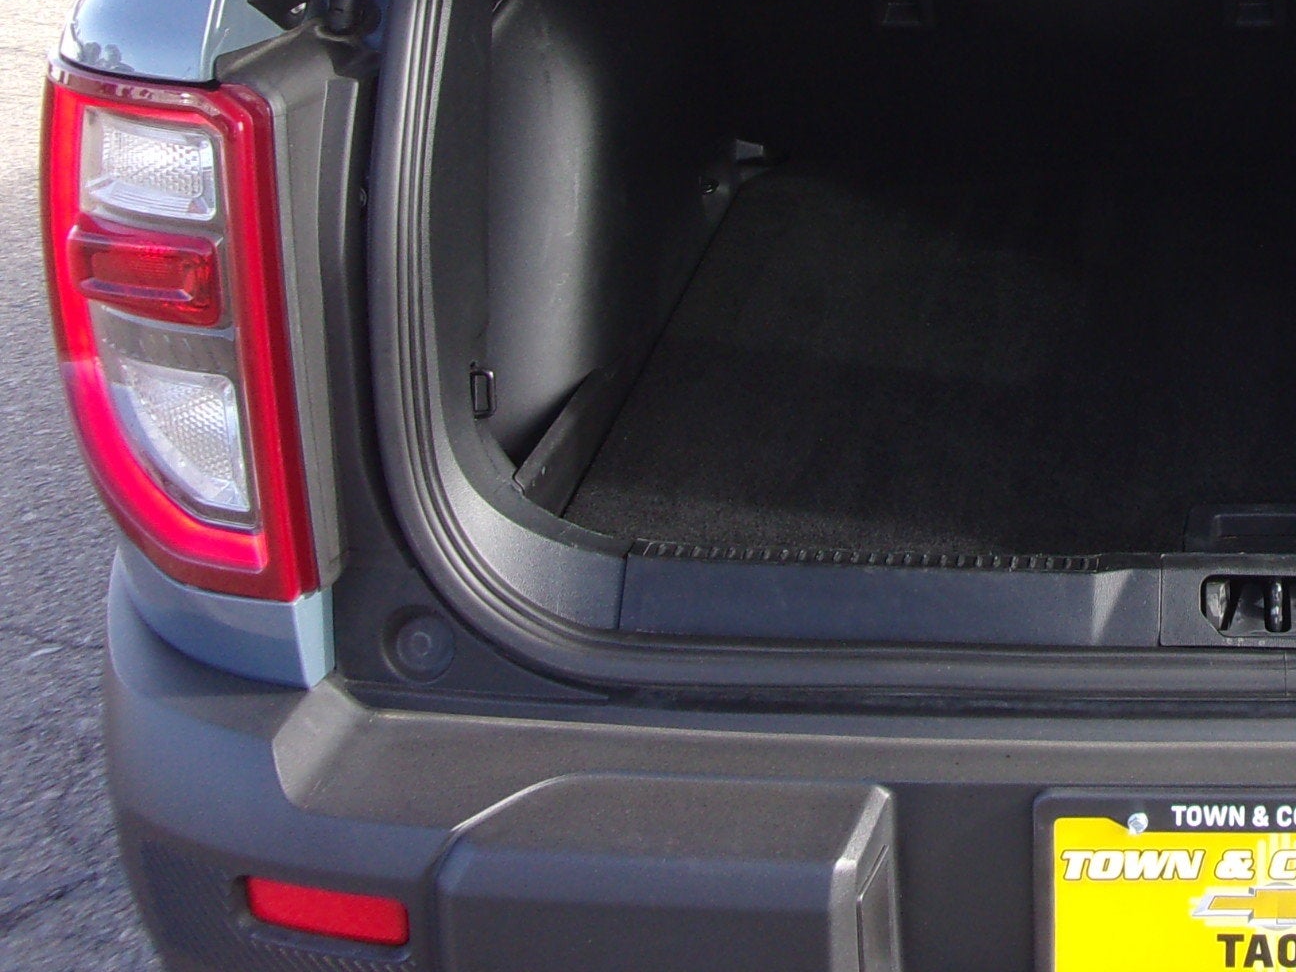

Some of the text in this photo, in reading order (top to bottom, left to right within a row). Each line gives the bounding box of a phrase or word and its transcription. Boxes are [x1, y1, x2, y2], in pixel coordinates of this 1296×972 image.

[1171, 805, 1245, 827] TOWN
[1252, 805, 1269, 827] &
[1061, 849, 1206, 880] TOWN
[1214, 849, 1255, 880] &
